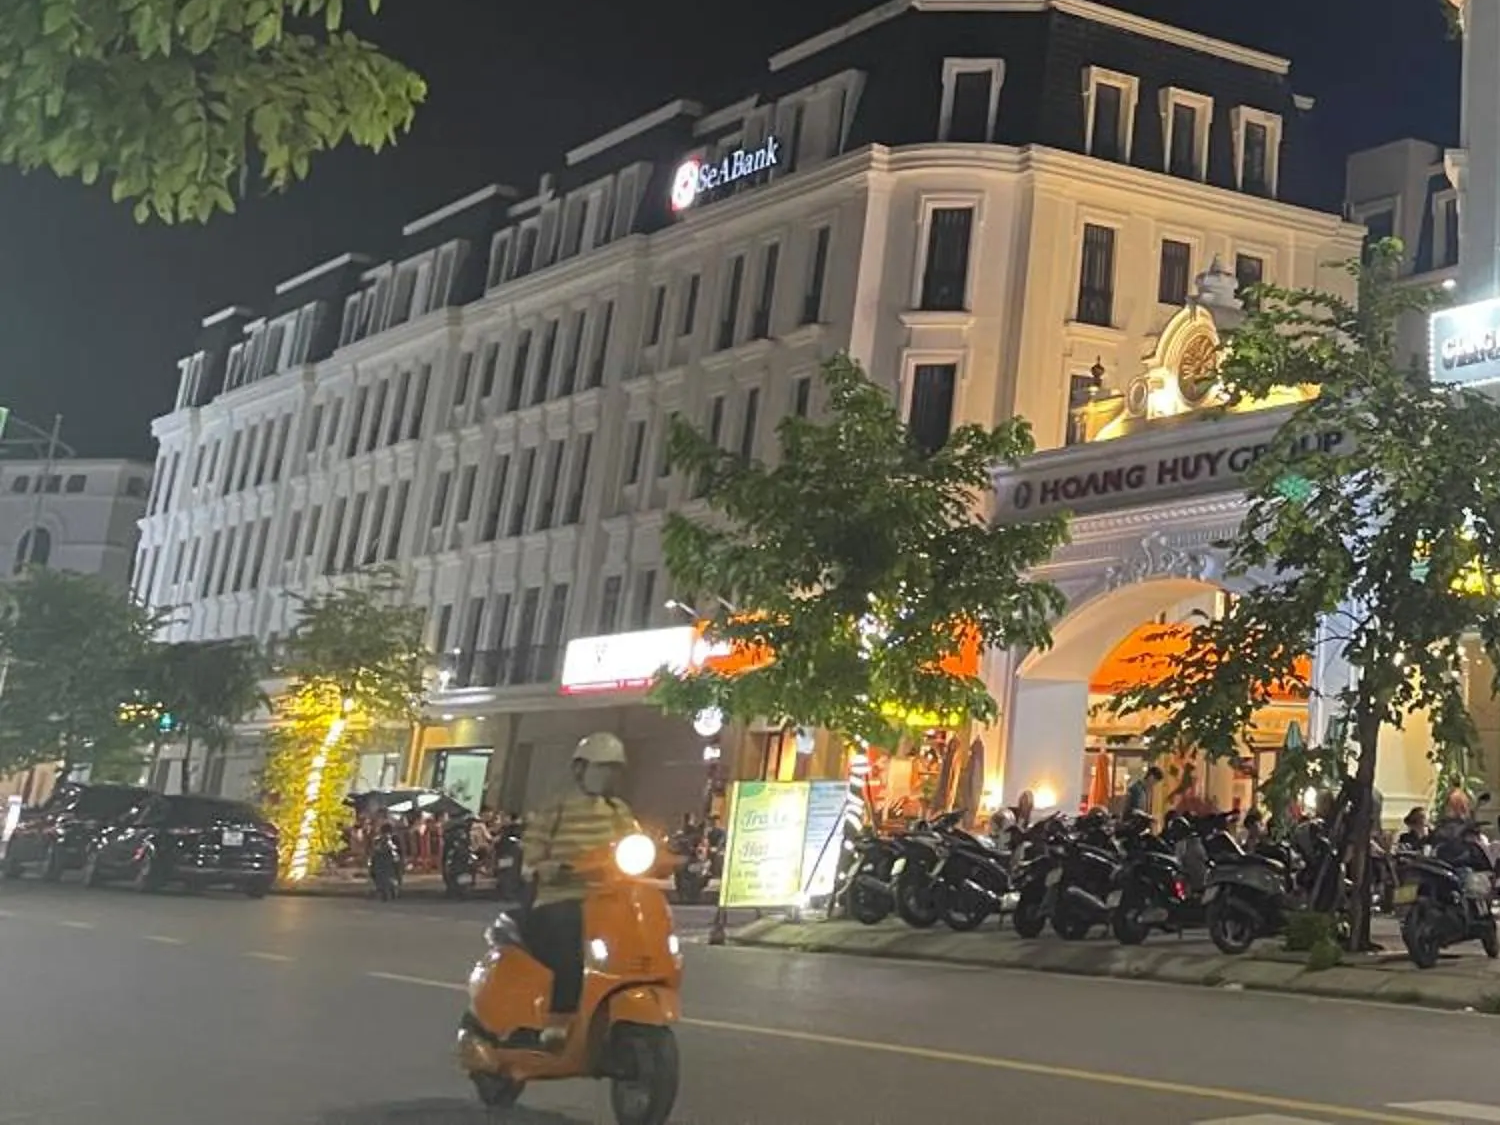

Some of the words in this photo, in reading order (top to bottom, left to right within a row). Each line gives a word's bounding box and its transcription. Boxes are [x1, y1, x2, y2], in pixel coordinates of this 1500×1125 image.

[696, 135, 780, 194] SeABank
[1039, 463, 1147, 506] HOANG
[1157, 448, 1228, 489] HUY
[1228, 431, 1343, 473] GRUP
